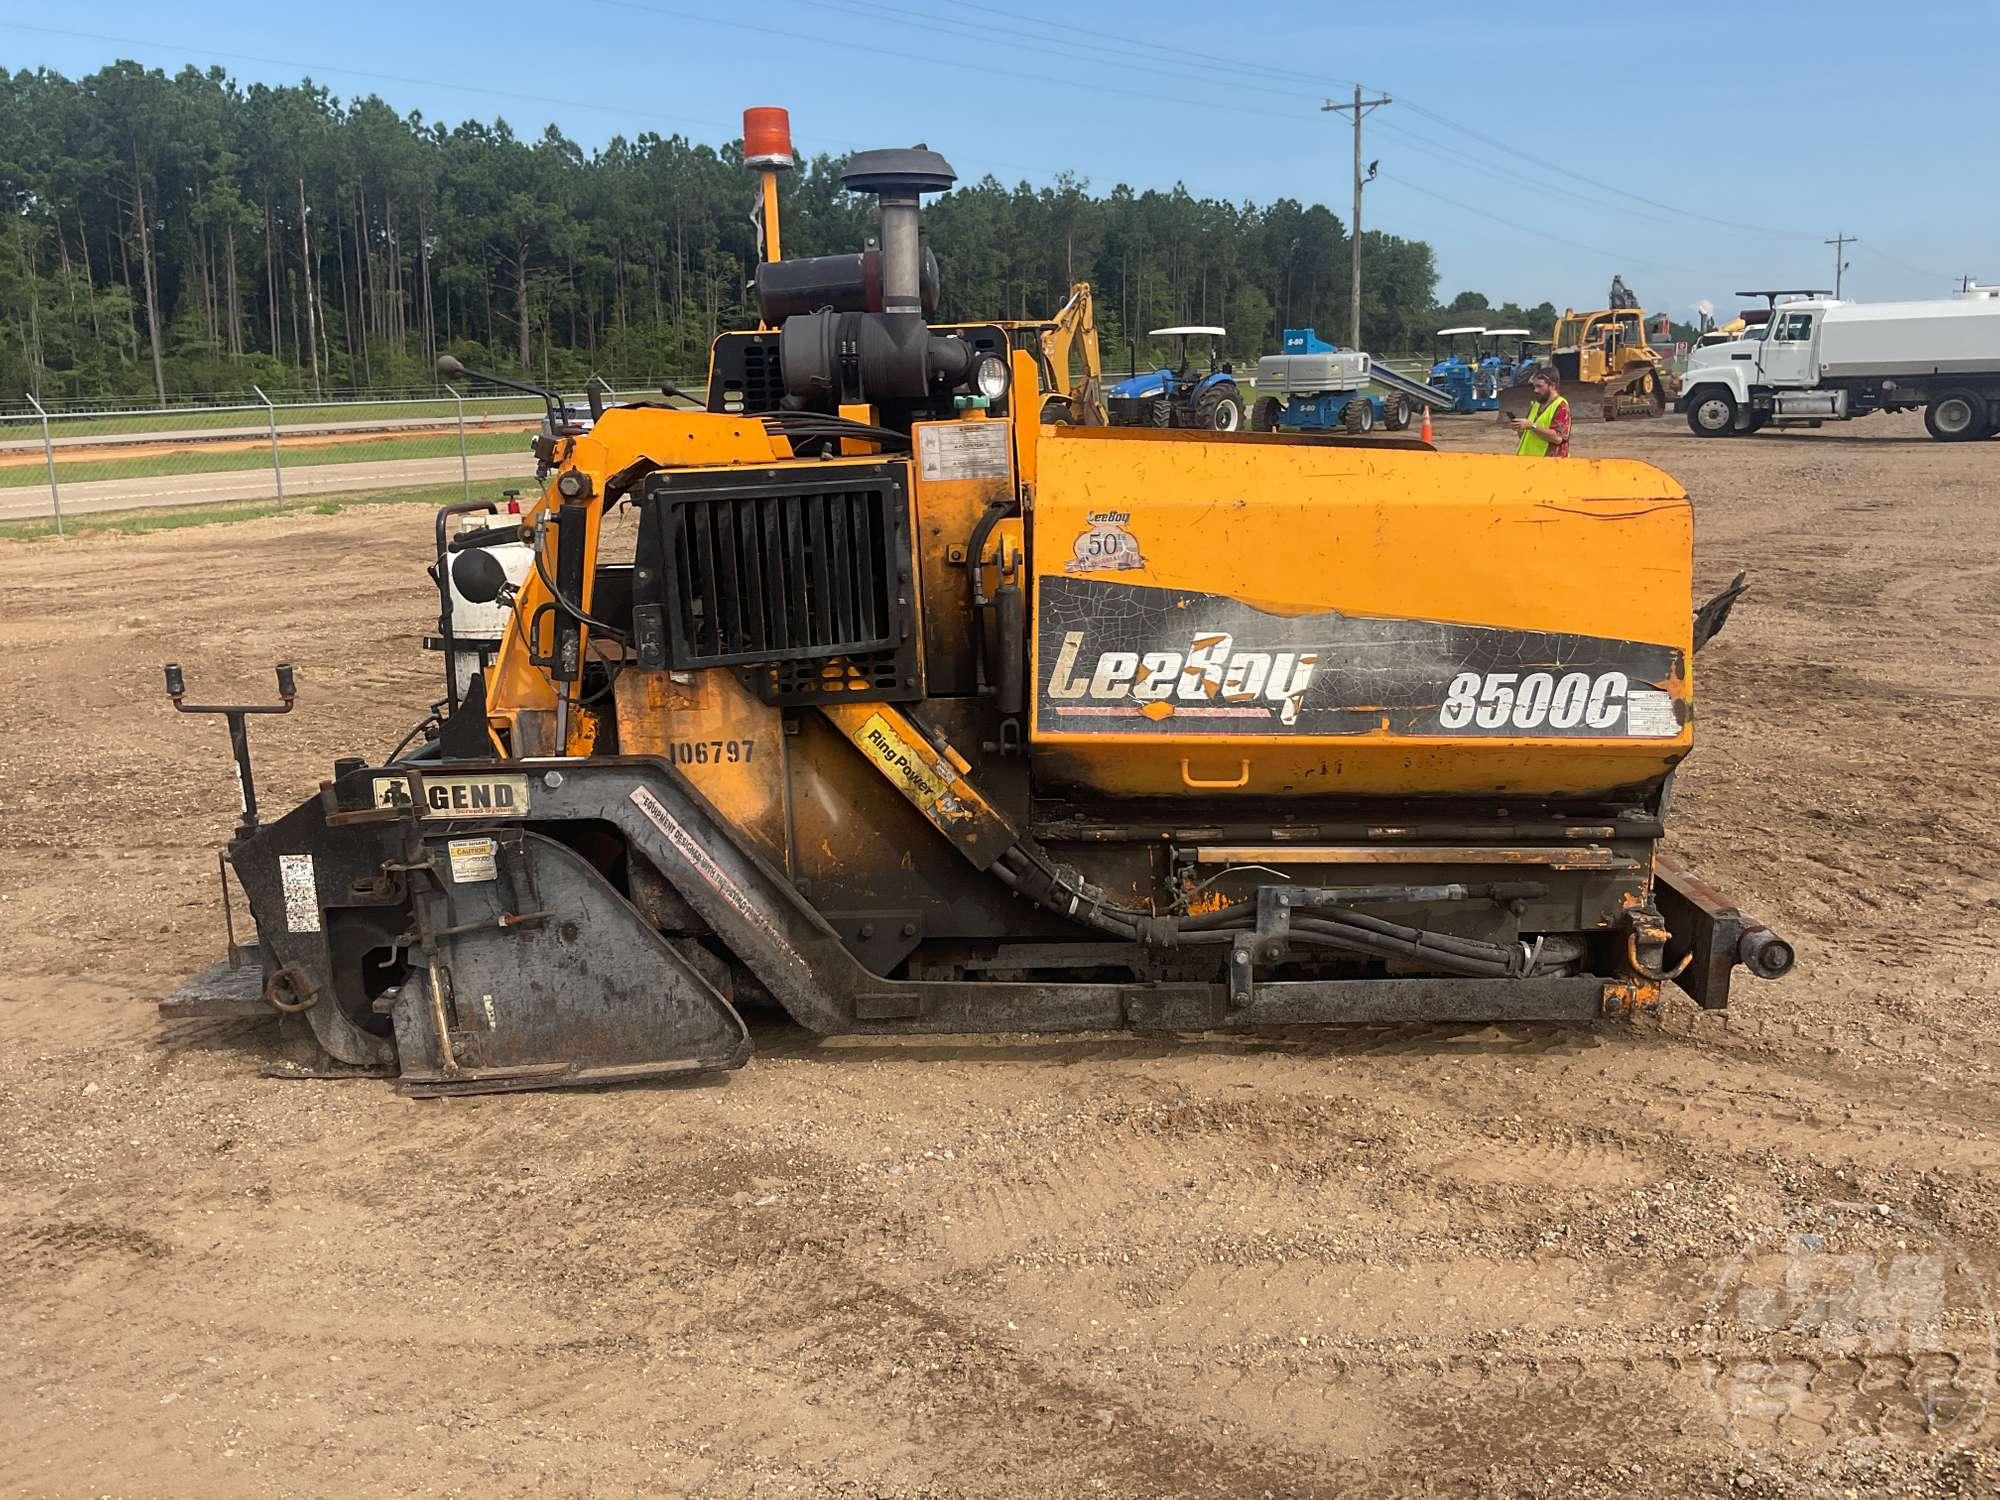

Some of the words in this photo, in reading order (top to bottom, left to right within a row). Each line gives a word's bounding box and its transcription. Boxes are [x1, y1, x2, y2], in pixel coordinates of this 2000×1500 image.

[1047, 631, 1319, 726] LeeBoy
[1438, 671, 1628, 731] 8500C
[868, 729, 897, 761] Ring
[894, 756, 934, 796] Power
[428, 784, 514, 809] GEND
